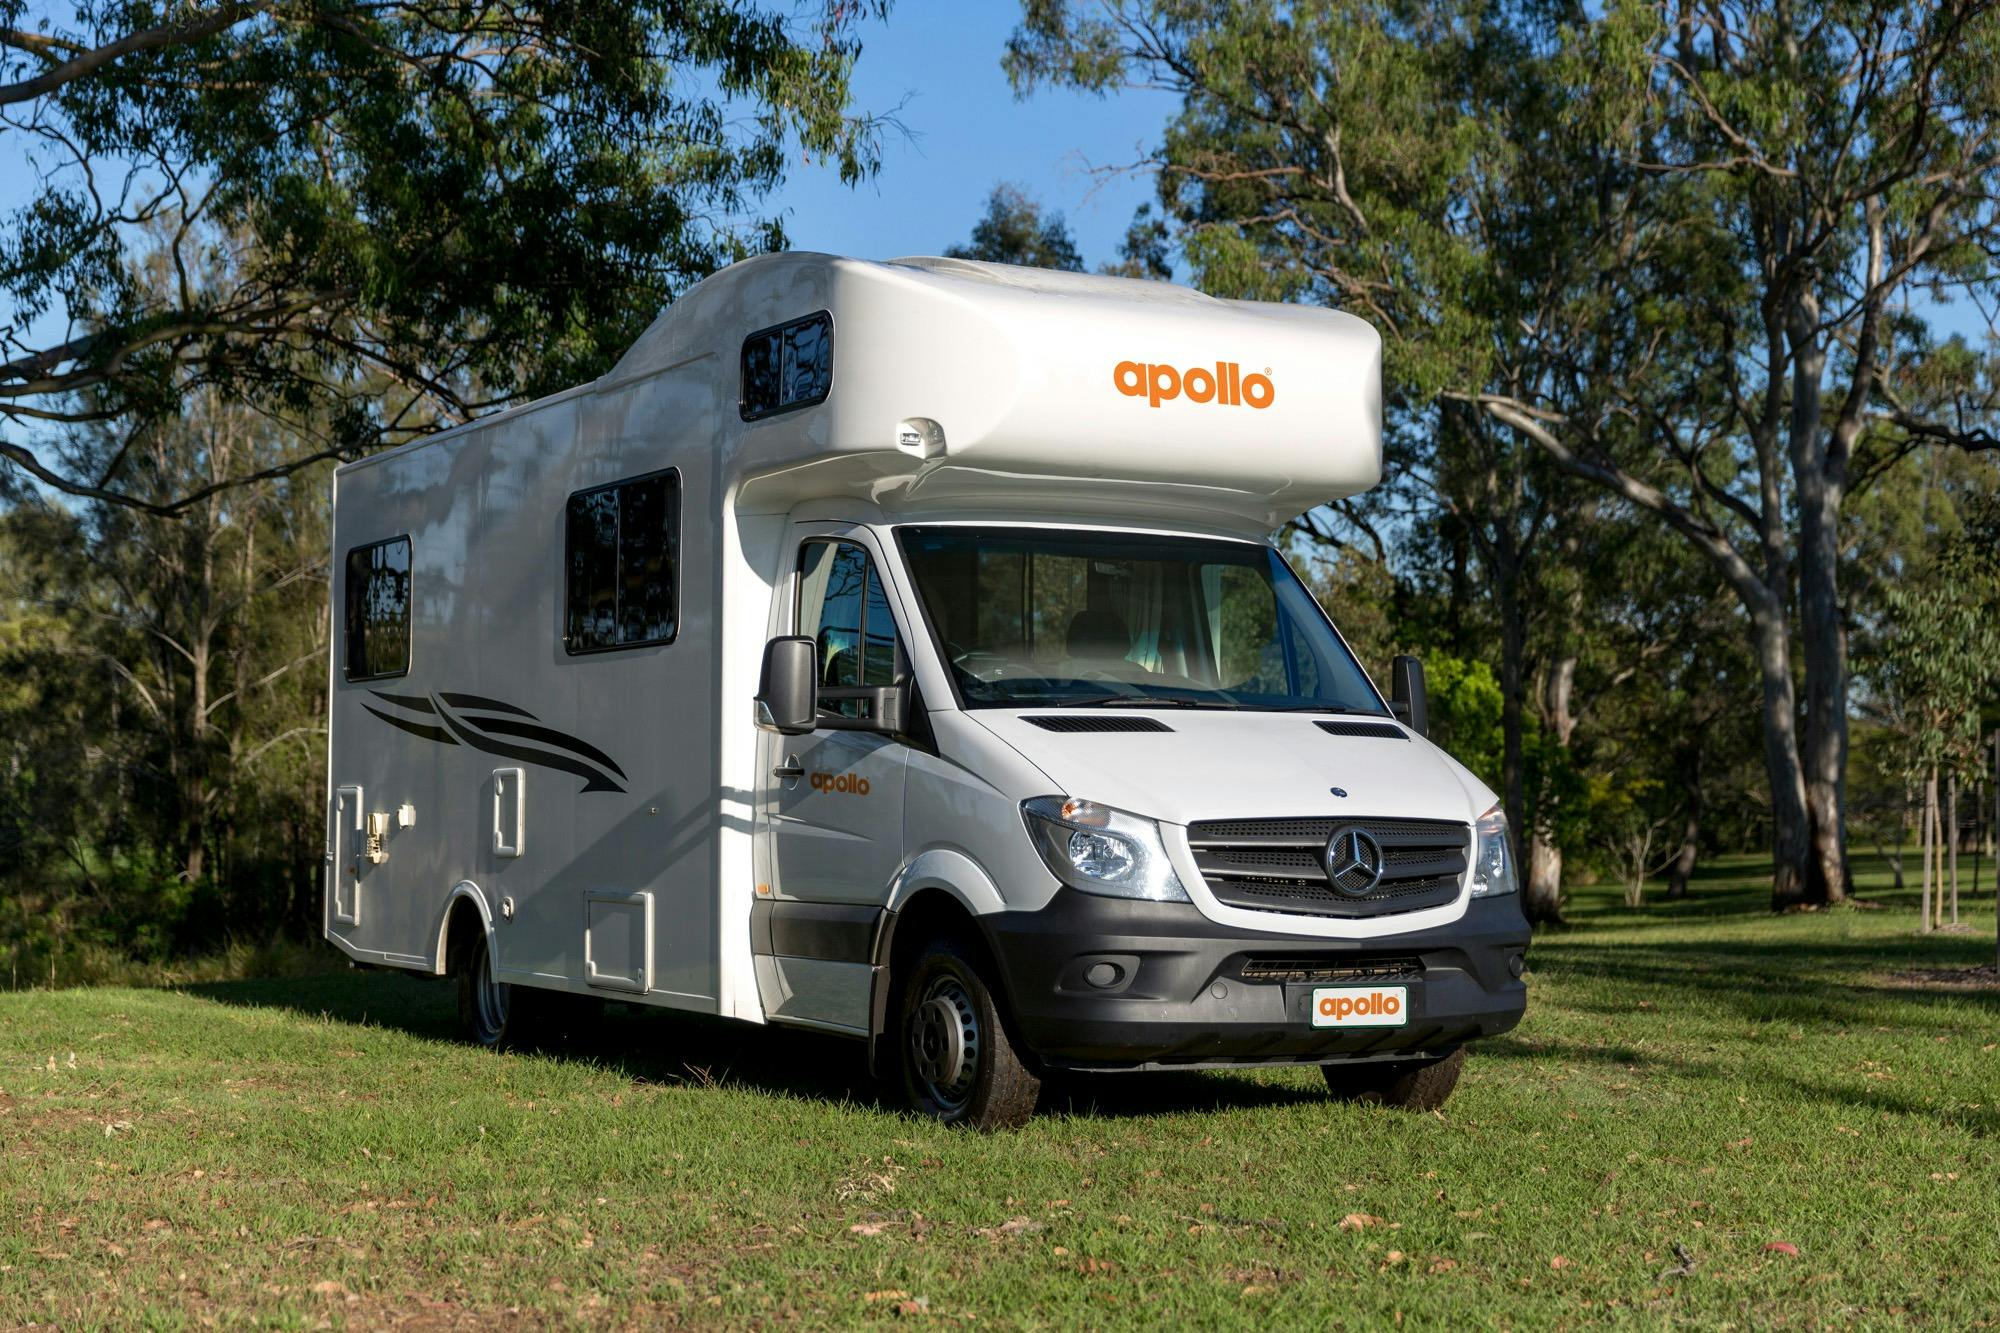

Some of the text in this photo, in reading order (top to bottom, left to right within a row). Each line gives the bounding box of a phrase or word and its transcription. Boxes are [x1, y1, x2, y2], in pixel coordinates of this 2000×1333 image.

[1114, 361, 1274, 409] apollo
[810, 772, 870, 795] apollo
[1320, 993, 1400, 1020] apollo
